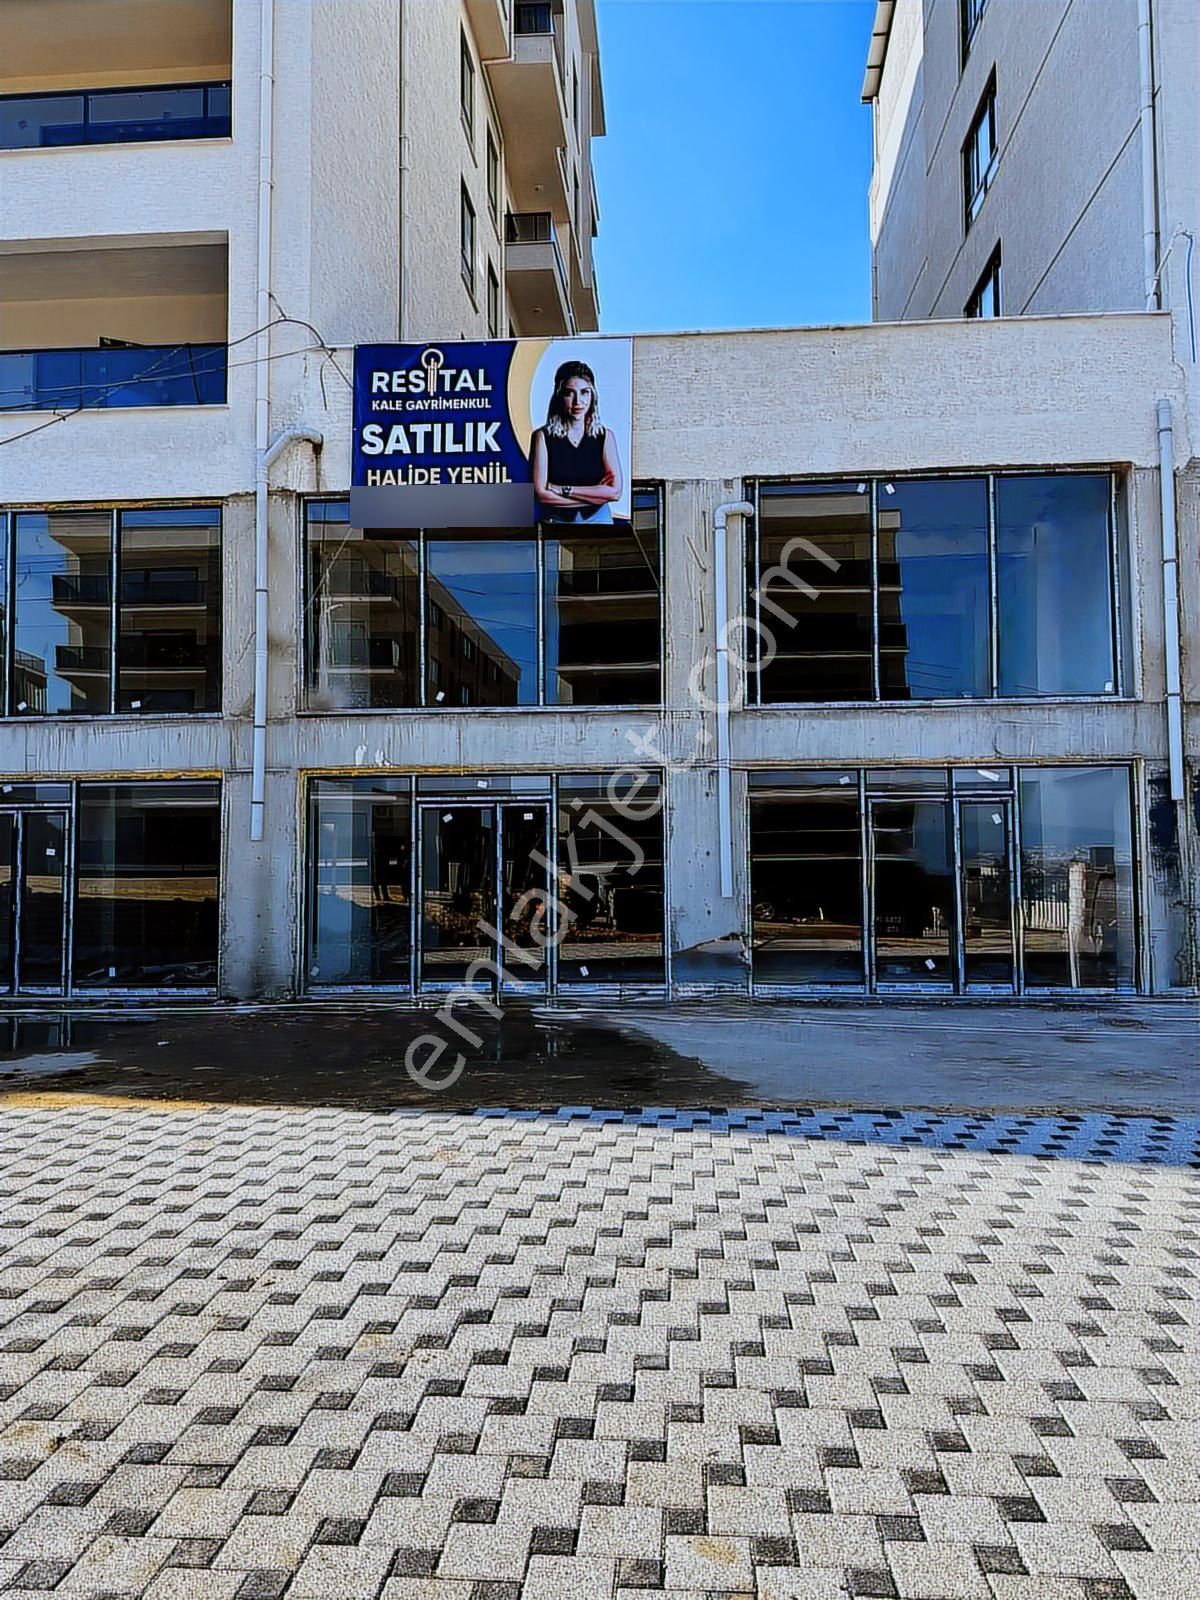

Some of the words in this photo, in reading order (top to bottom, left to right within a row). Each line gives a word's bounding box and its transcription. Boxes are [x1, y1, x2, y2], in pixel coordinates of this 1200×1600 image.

[372, 400, 402, 411] KALE
[406, 396, 492, 411] GAYRİMENKUL
[361, 422, 501, 455] SATILIK
[367, 464, 441, 487] HALİDE
